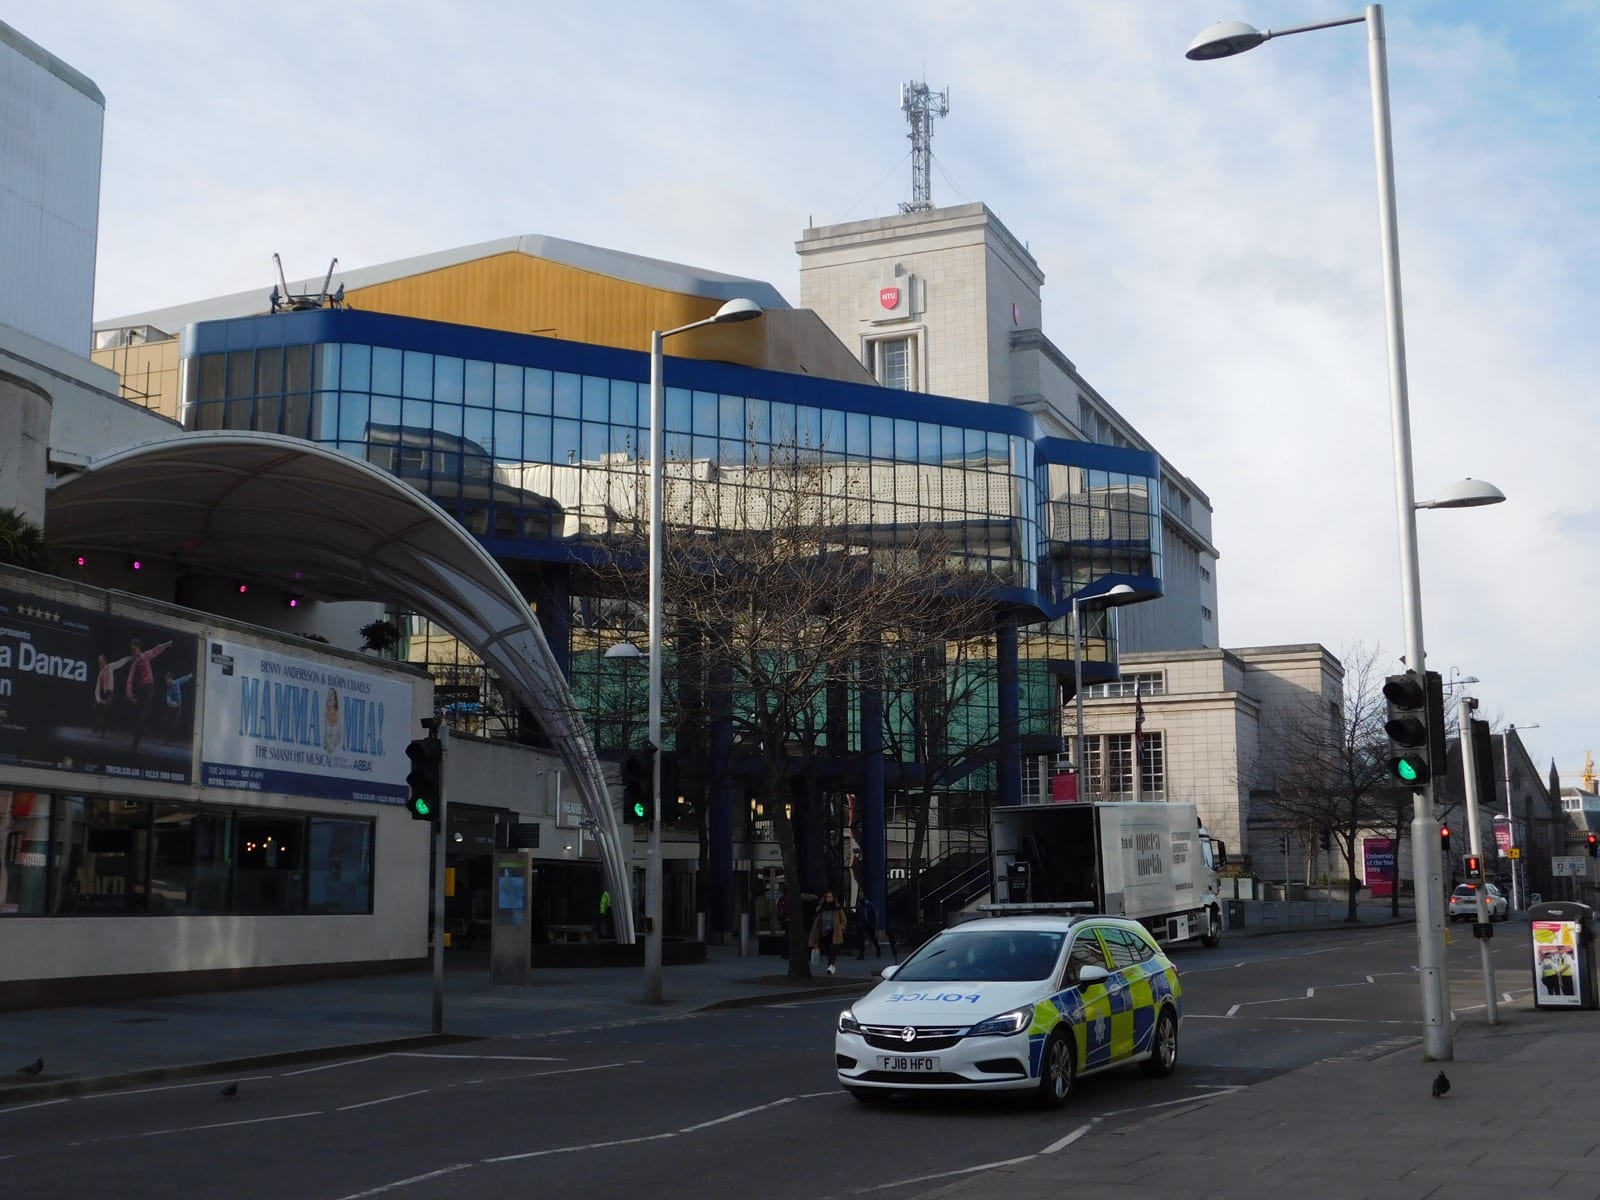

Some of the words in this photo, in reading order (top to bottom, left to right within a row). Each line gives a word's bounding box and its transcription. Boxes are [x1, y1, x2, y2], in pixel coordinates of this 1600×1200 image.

[882, 292, 896, 301] NTU
[18, 641, 88, 682] Danza
[260, 660, 282, 676] BENNY
[283, 665, 320, 683] ANDERSSON
[320, 675, 326, 685] &
[327, 672, 347, 689] BJÖRN
[239, 675, 321, 748] MAMMA
[342, 696, 385, 757] MIA!
[255, 745, 269, 759] THE
[269, 747, 293, 763] SMASH
[293, 749, 304, 764] HIT
[306, 751, 332, 768] MUSICAL
[352, 759, 373, 772] ABBA
[1135, 833, 1160, 855] opera
[1137, 853, 1162, 876] north
[884, 1057, 907, 1070] FJ18
